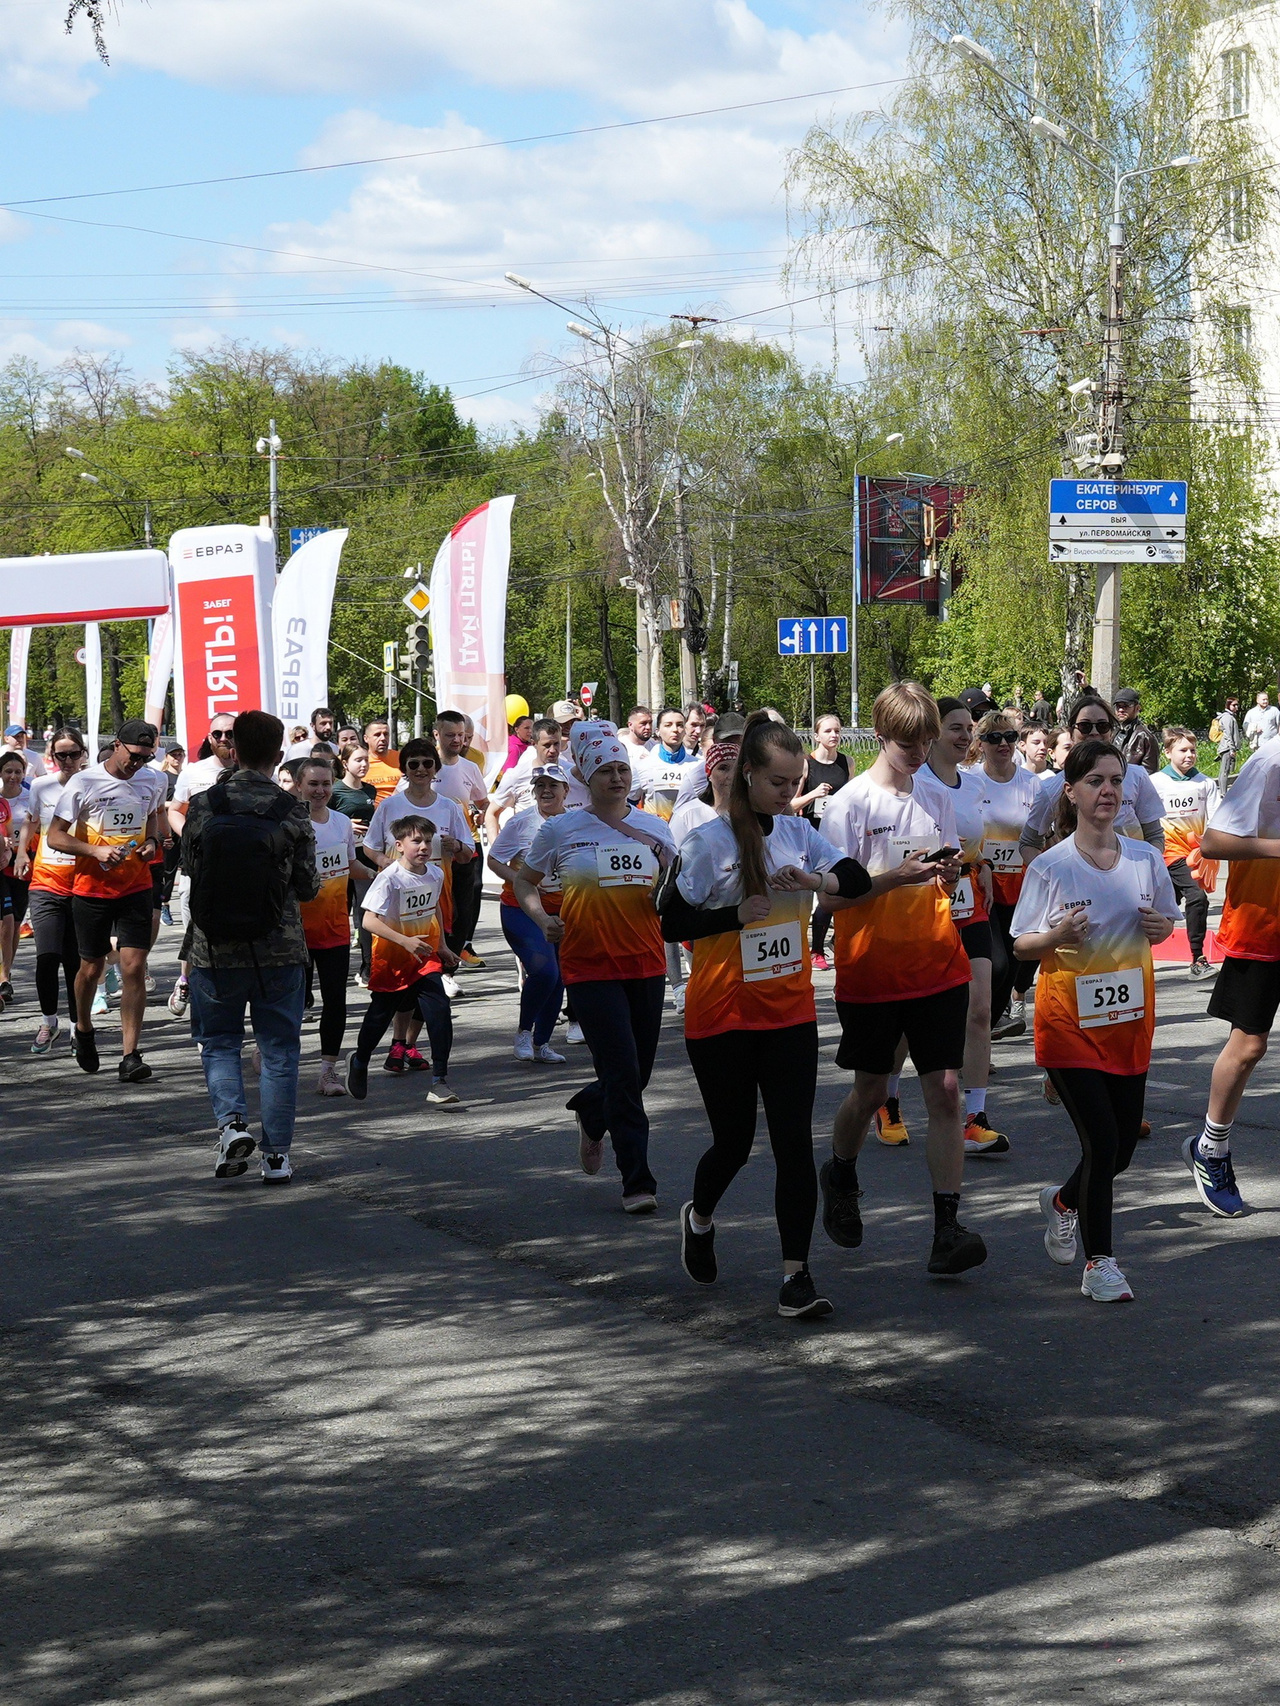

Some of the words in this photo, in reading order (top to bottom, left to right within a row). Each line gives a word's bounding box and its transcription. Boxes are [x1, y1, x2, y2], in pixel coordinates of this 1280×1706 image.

[1076, 484, 1164, 495] ЕКАТЕРИНБУРГ
[1076, 500, 1117, 510] СЕРОВ
[195, 543, 244, 557] ЕВРАЗ
[1073, 547, 1136, 555] Видеонаблюдение
[203, 598, 232, 609] ЗАБЕГ
[203, 614, 239, 720] ПЯТЬ!
[662, 772, 681, 781] 494
[1169, 797, 1194, 808] 1069
[113, 813, 134, 825] 529
[993, 849, 1014, 860] 517
[322, 854, 341, 868] 814
[610, 855, 642, 870] 886
[406, 892, 432, 909] 1207
[1064, 899, 1092, 910] ЕВРАЗ
[758, 937, 790, 961] 540
[1093, 984, 1130, 1008] 528
